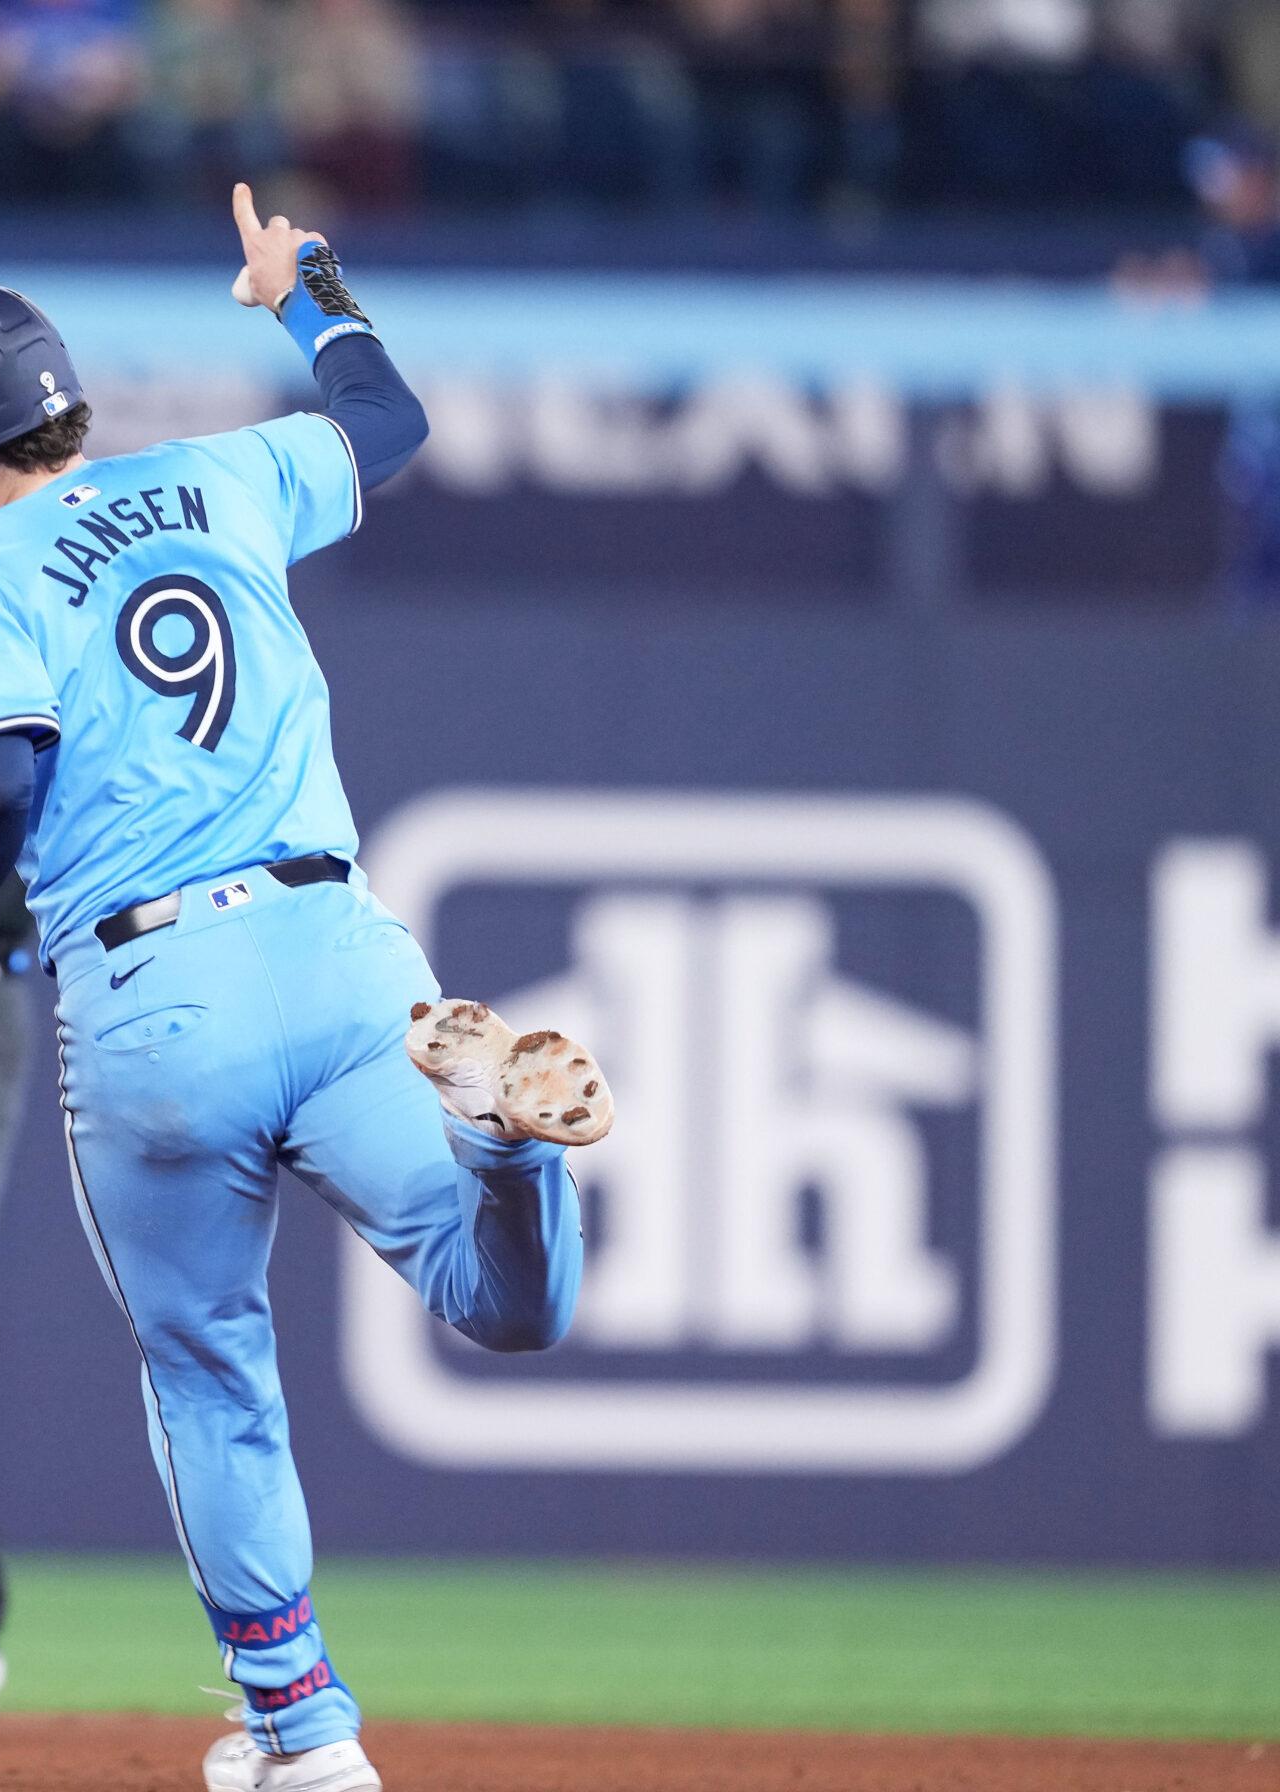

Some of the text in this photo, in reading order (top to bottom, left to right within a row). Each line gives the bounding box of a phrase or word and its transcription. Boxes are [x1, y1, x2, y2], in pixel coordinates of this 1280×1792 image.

[40, 371, 55, 395] 9
[41, 485, 210, 608] JANSEN
[115, 573, 236, 753] 9
